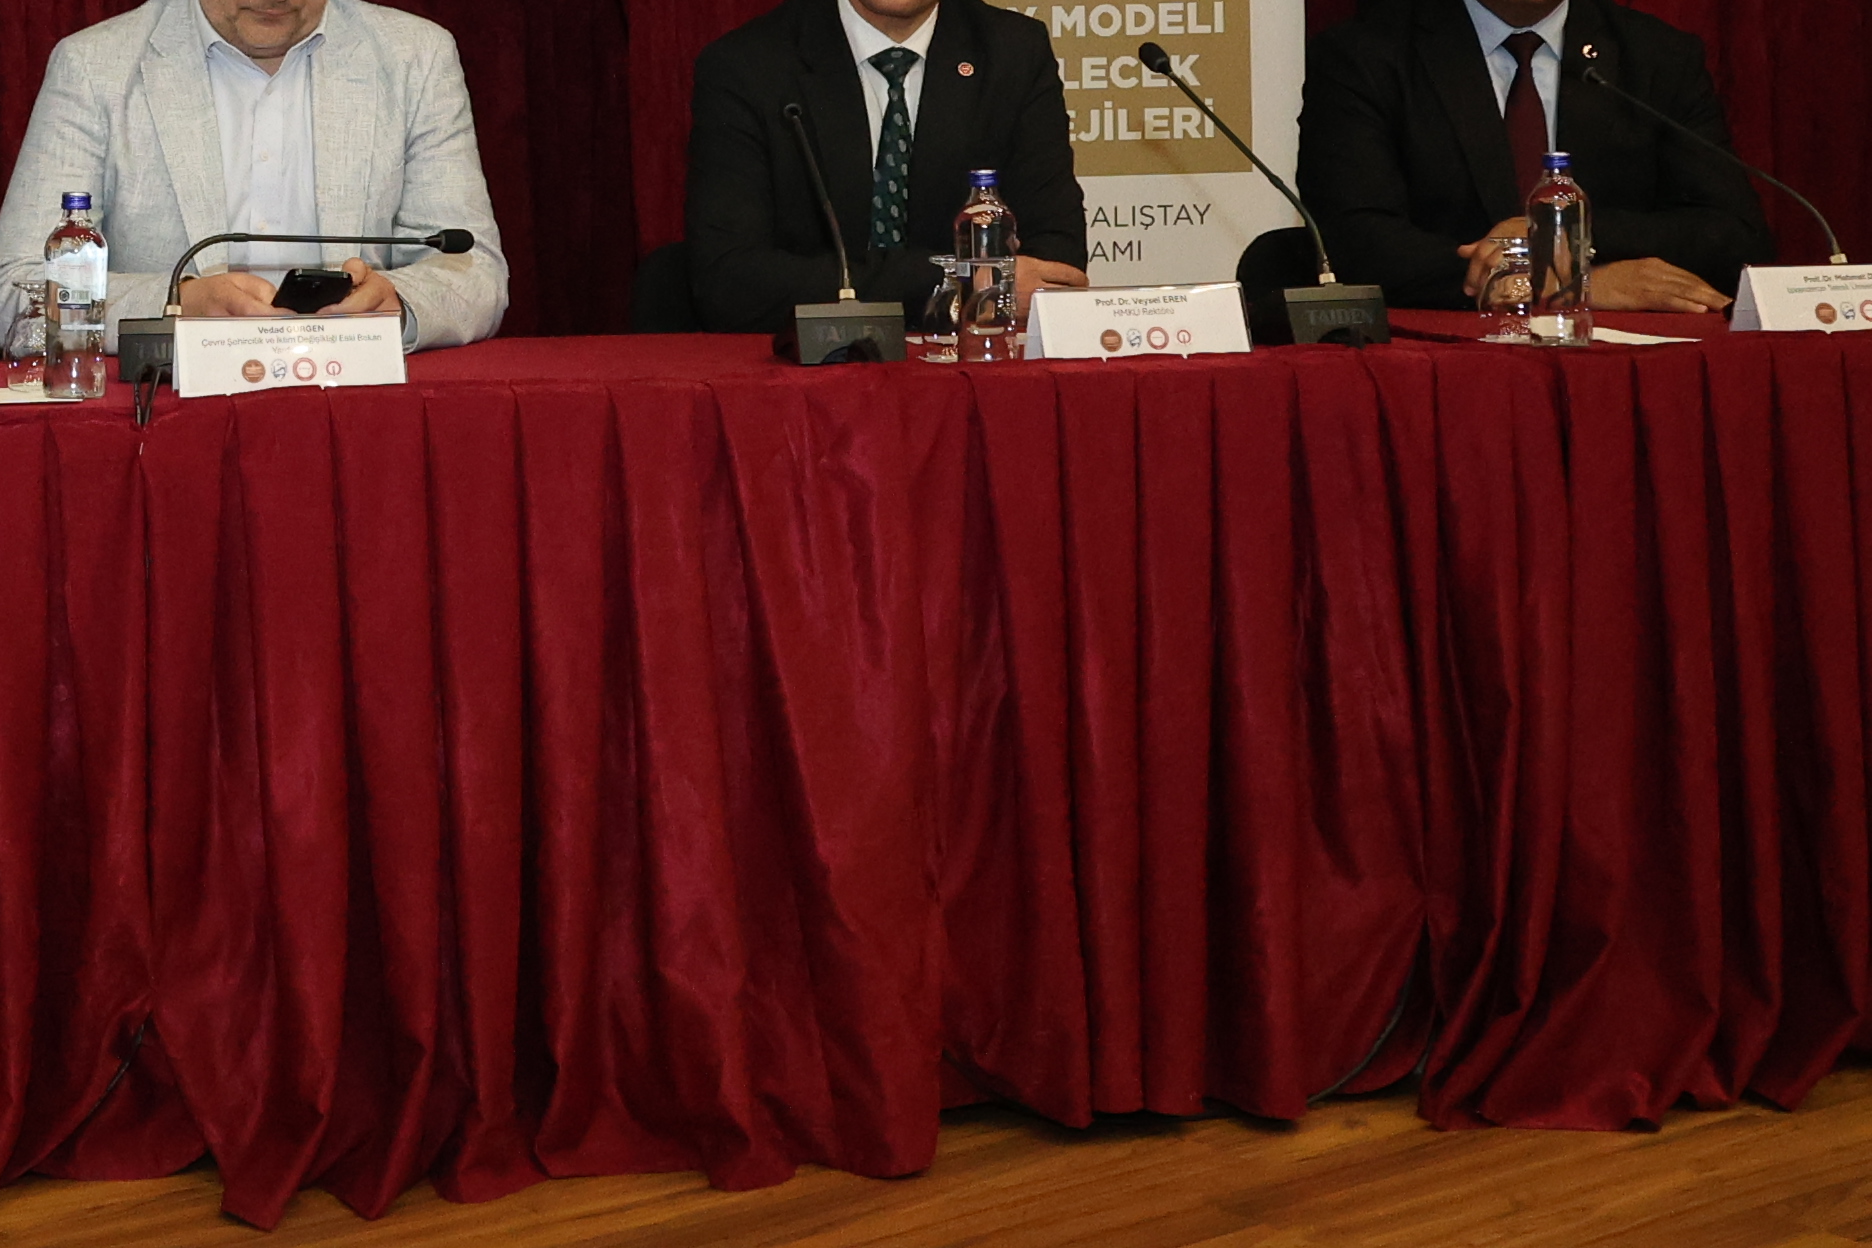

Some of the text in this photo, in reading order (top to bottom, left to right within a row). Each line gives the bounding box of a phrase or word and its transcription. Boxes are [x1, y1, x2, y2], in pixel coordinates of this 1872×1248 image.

[1058, 54, 1201, 90] LECEK
[1084, 203, 1211, 230] ALIŞTAY
[1088, 240, 1142, 262] AMI
[1117, 297, 1131, 306] Dr.
[1162, 295, 1188, 303] EREN
[258, 326, 284, 334] Vedad
